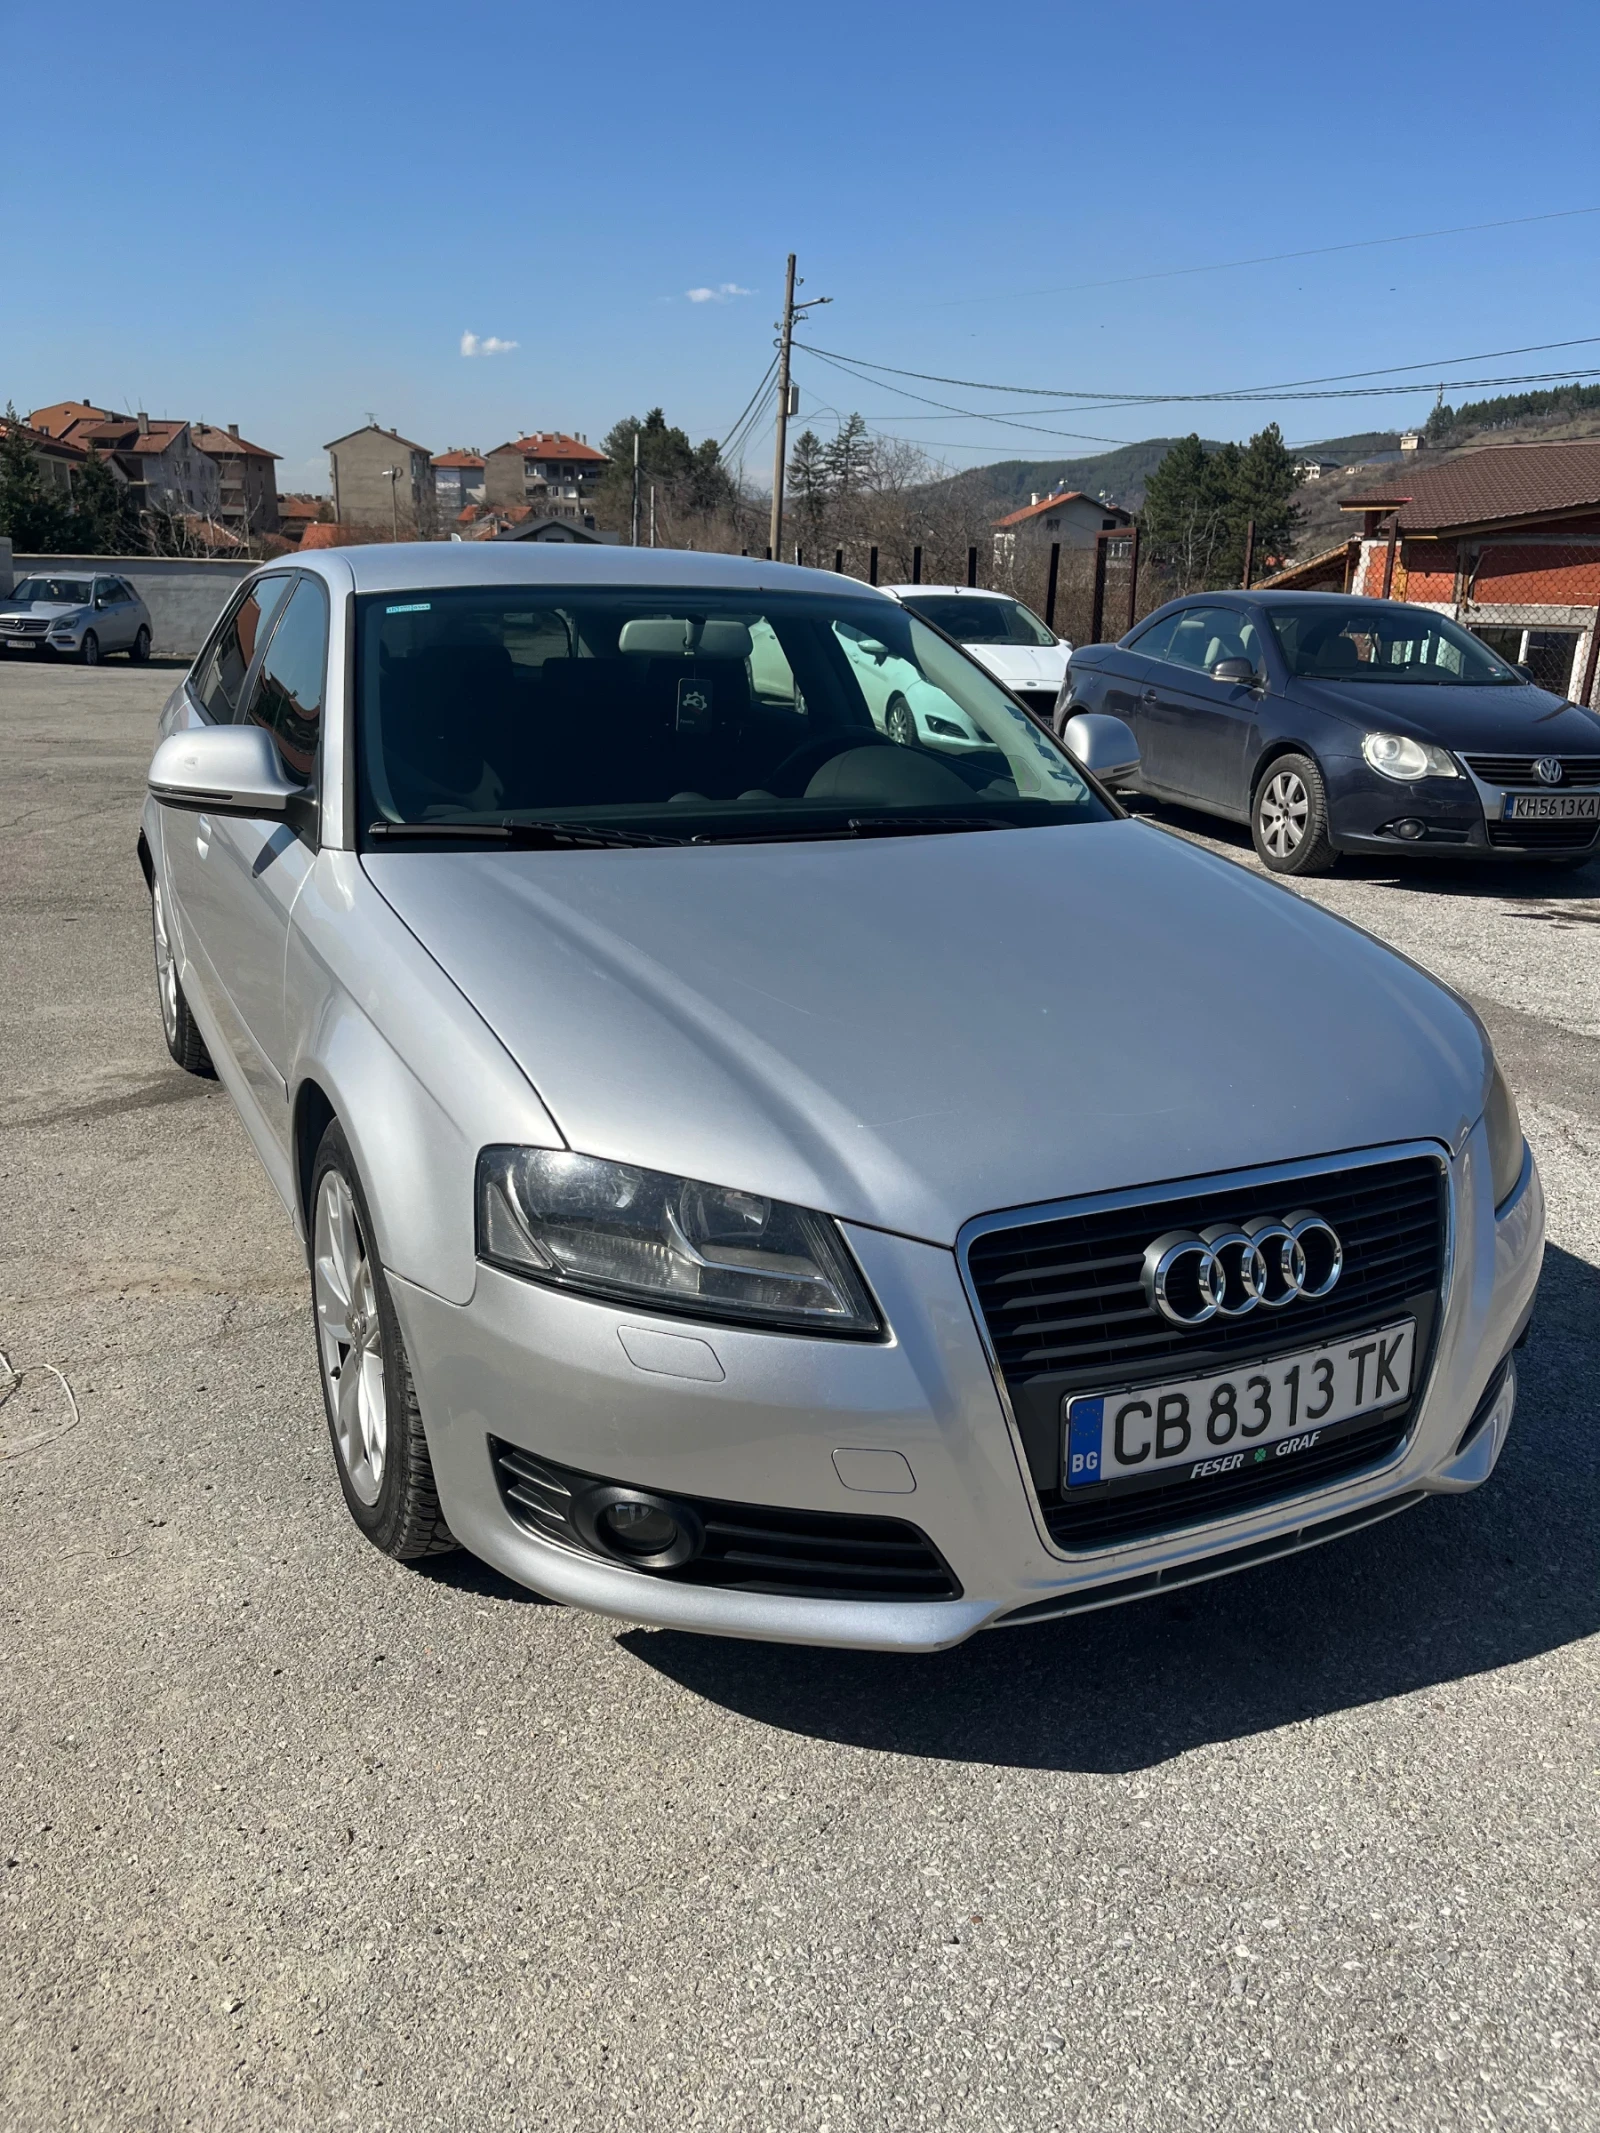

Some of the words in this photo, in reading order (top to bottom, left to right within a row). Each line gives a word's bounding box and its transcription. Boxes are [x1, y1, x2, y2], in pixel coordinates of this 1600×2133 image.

[1114, 1393, 1192, 1466] CB
[1206, 1358, 1335, 1446] 8313
[1348, 1333, 1405, 1407] TK
[1071, 1450, 1098, 1473] BG
[1190, 1453, 1245, 1479] FESER
[1275, 1431, 1321, 1457] GRAF
